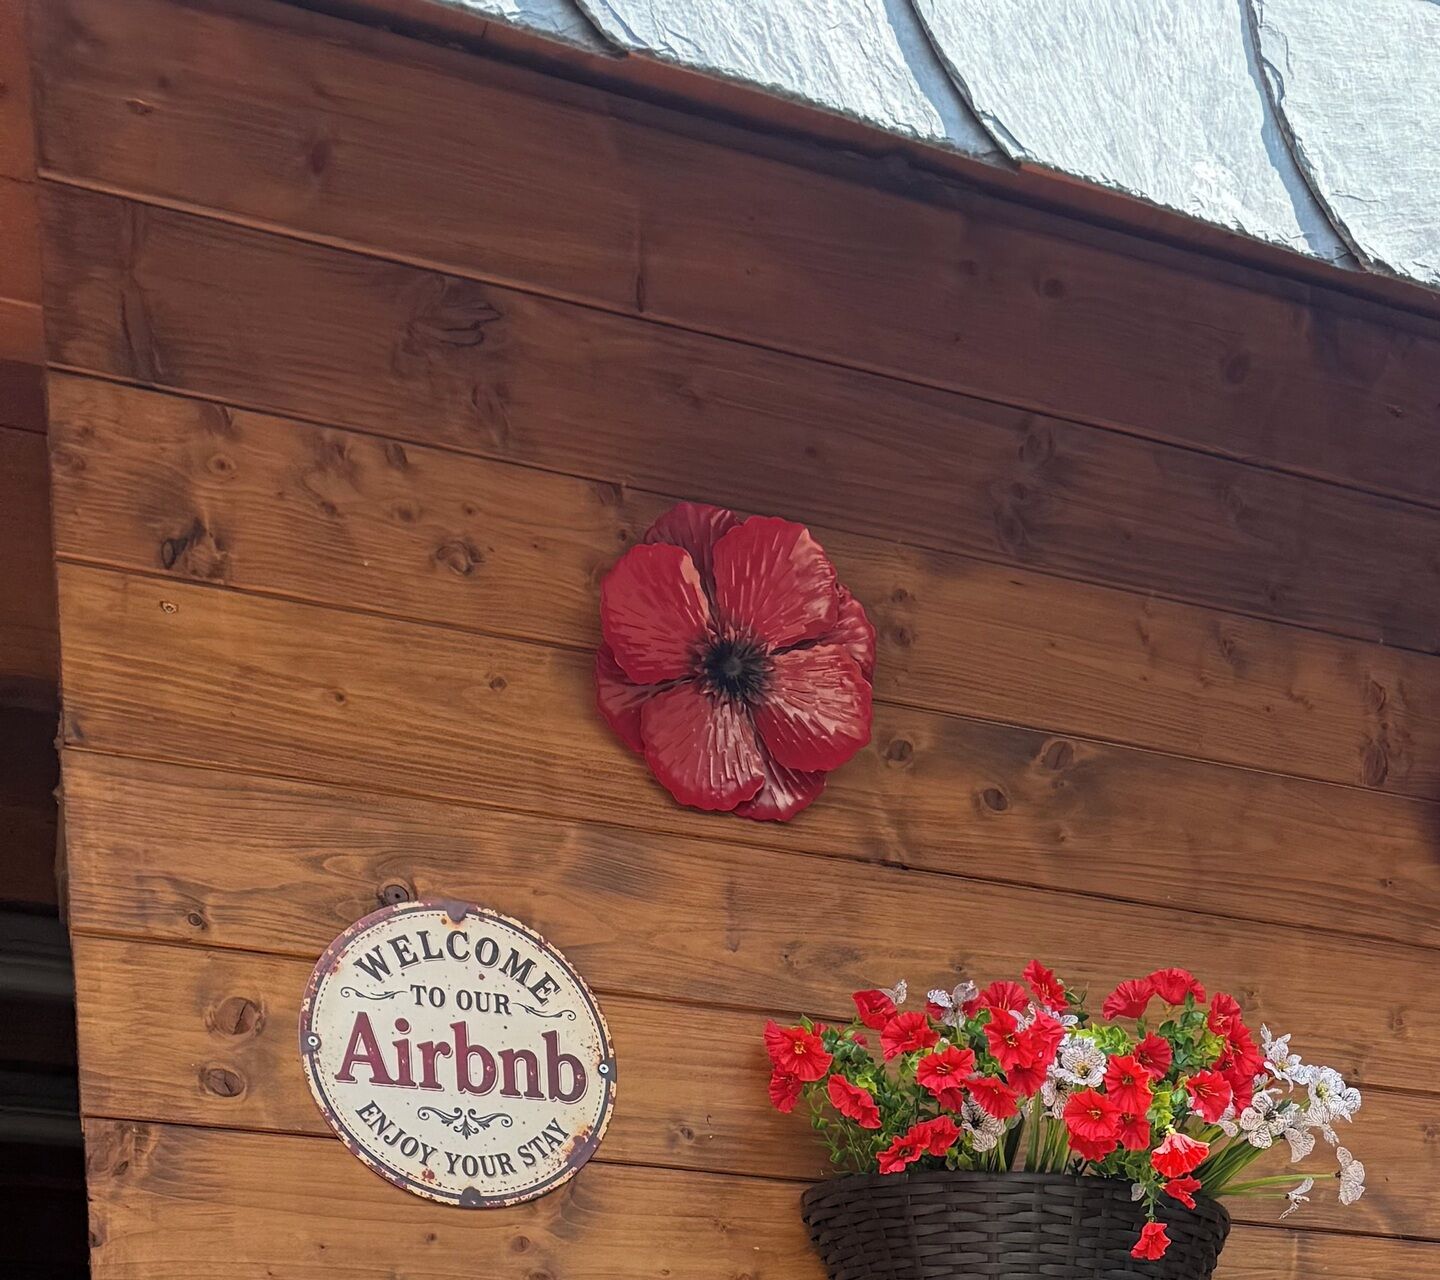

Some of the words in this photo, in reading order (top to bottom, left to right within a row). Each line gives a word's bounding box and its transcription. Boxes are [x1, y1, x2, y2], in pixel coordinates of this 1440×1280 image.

[352, 930, 562, 1005] WELCOME
[410, 984, 446, 1008] TO
[456, 989, 512, 1015] OUR
[334, 1011, 588, 1104] Airbnb
[355, 1100, 438, 1167] ENJOY
[445, 1152, 517, 1177] YOUR
[517, 1117, 570, 1168] STAY
